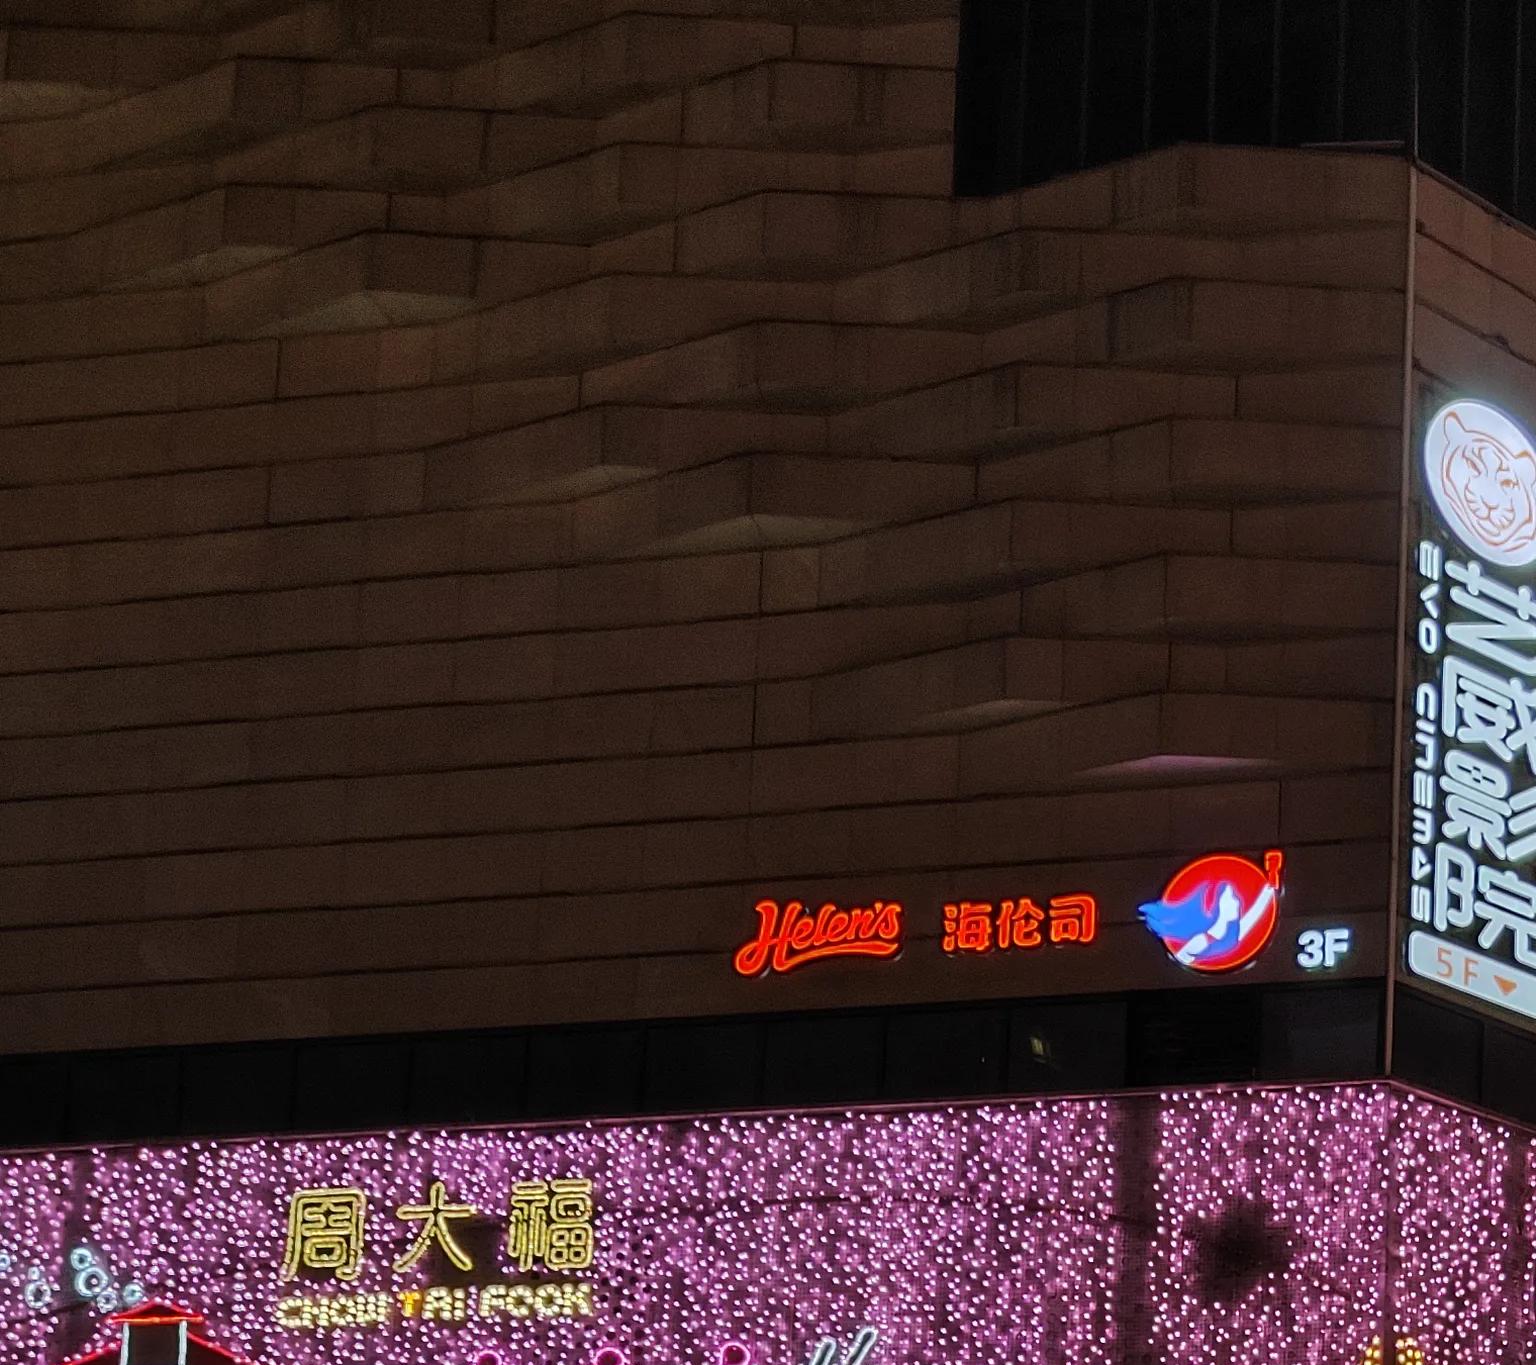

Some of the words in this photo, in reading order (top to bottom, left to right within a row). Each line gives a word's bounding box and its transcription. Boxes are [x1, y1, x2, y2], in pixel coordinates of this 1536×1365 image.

[1417, 540, 1441, 654] EVO
[735, 899, 902, 976] Helen's
[943, 893, 1096, 955] 海伦司
[1297, 928, 1351, 969] 3F
[281, 1178, 595, 1282] 周大福
[273, 1288, 394, 1329] CHOW
[400, 1286, 467, 1320] TAI
[479, 1282, 594, 1317] FOOK
